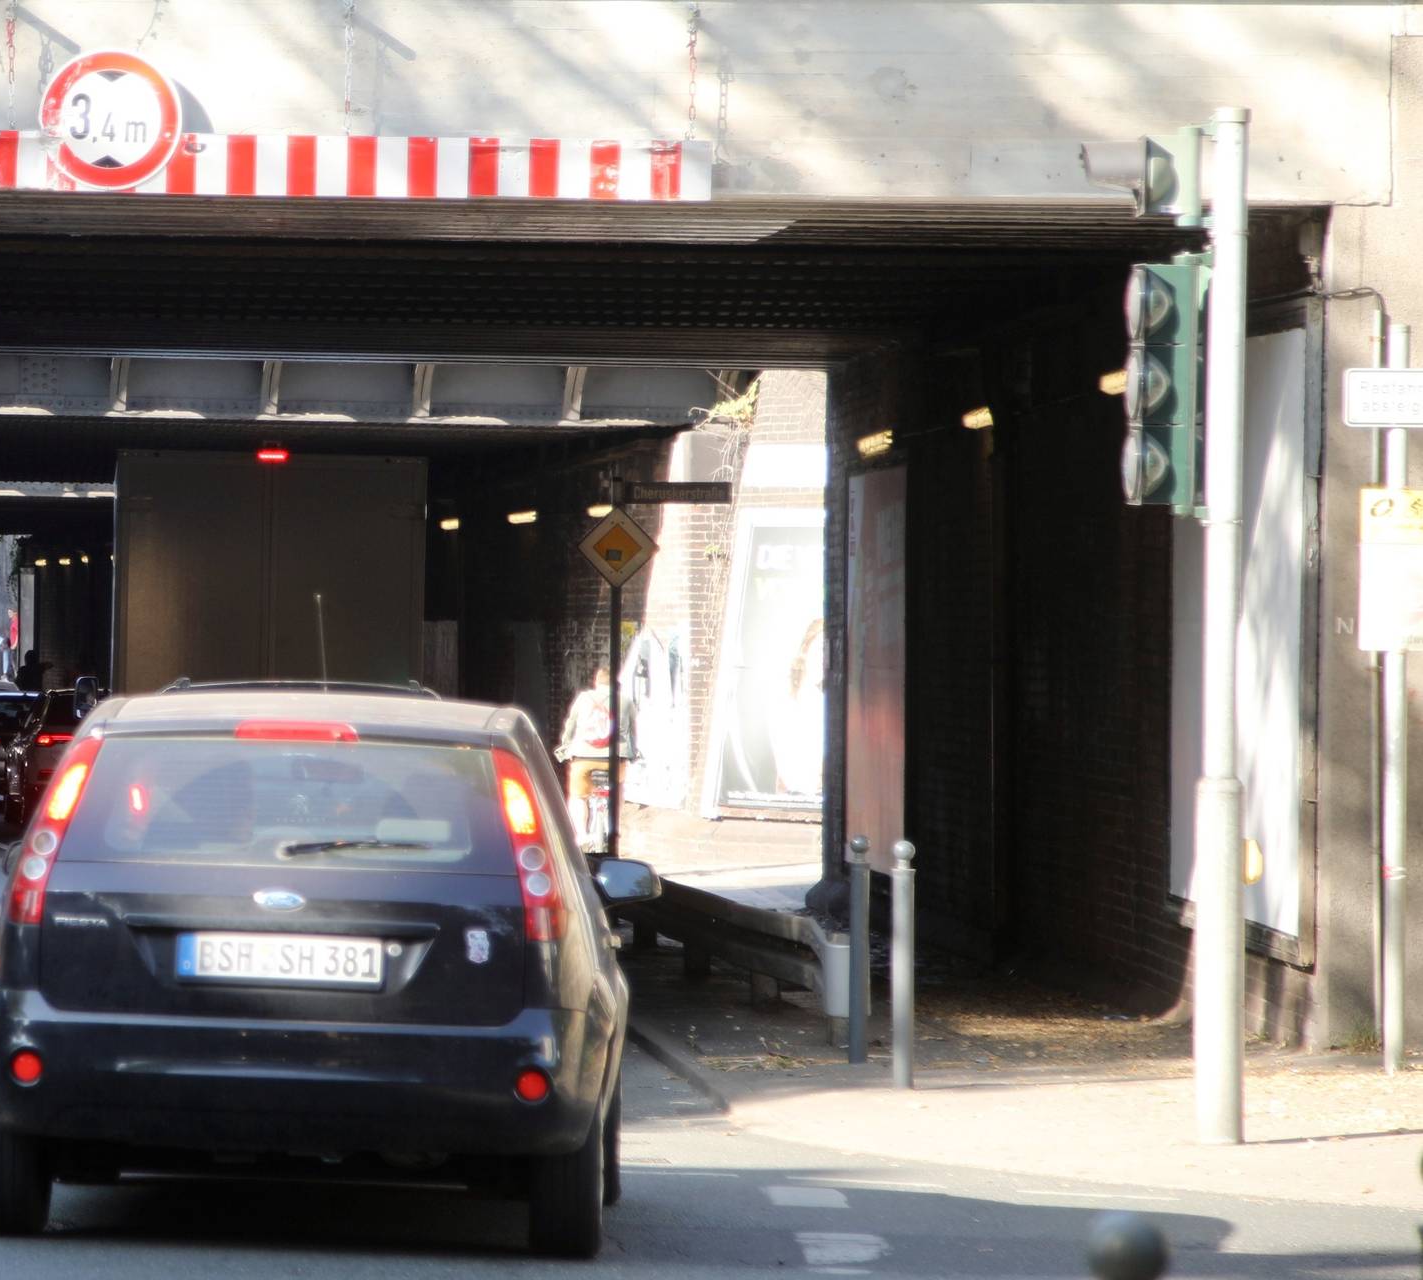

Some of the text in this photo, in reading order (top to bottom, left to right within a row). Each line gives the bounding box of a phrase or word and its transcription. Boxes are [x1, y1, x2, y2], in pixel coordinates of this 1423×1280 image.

[125, 120, 147, 143] m
[198, 940, 377, 979] BSH SH 381
